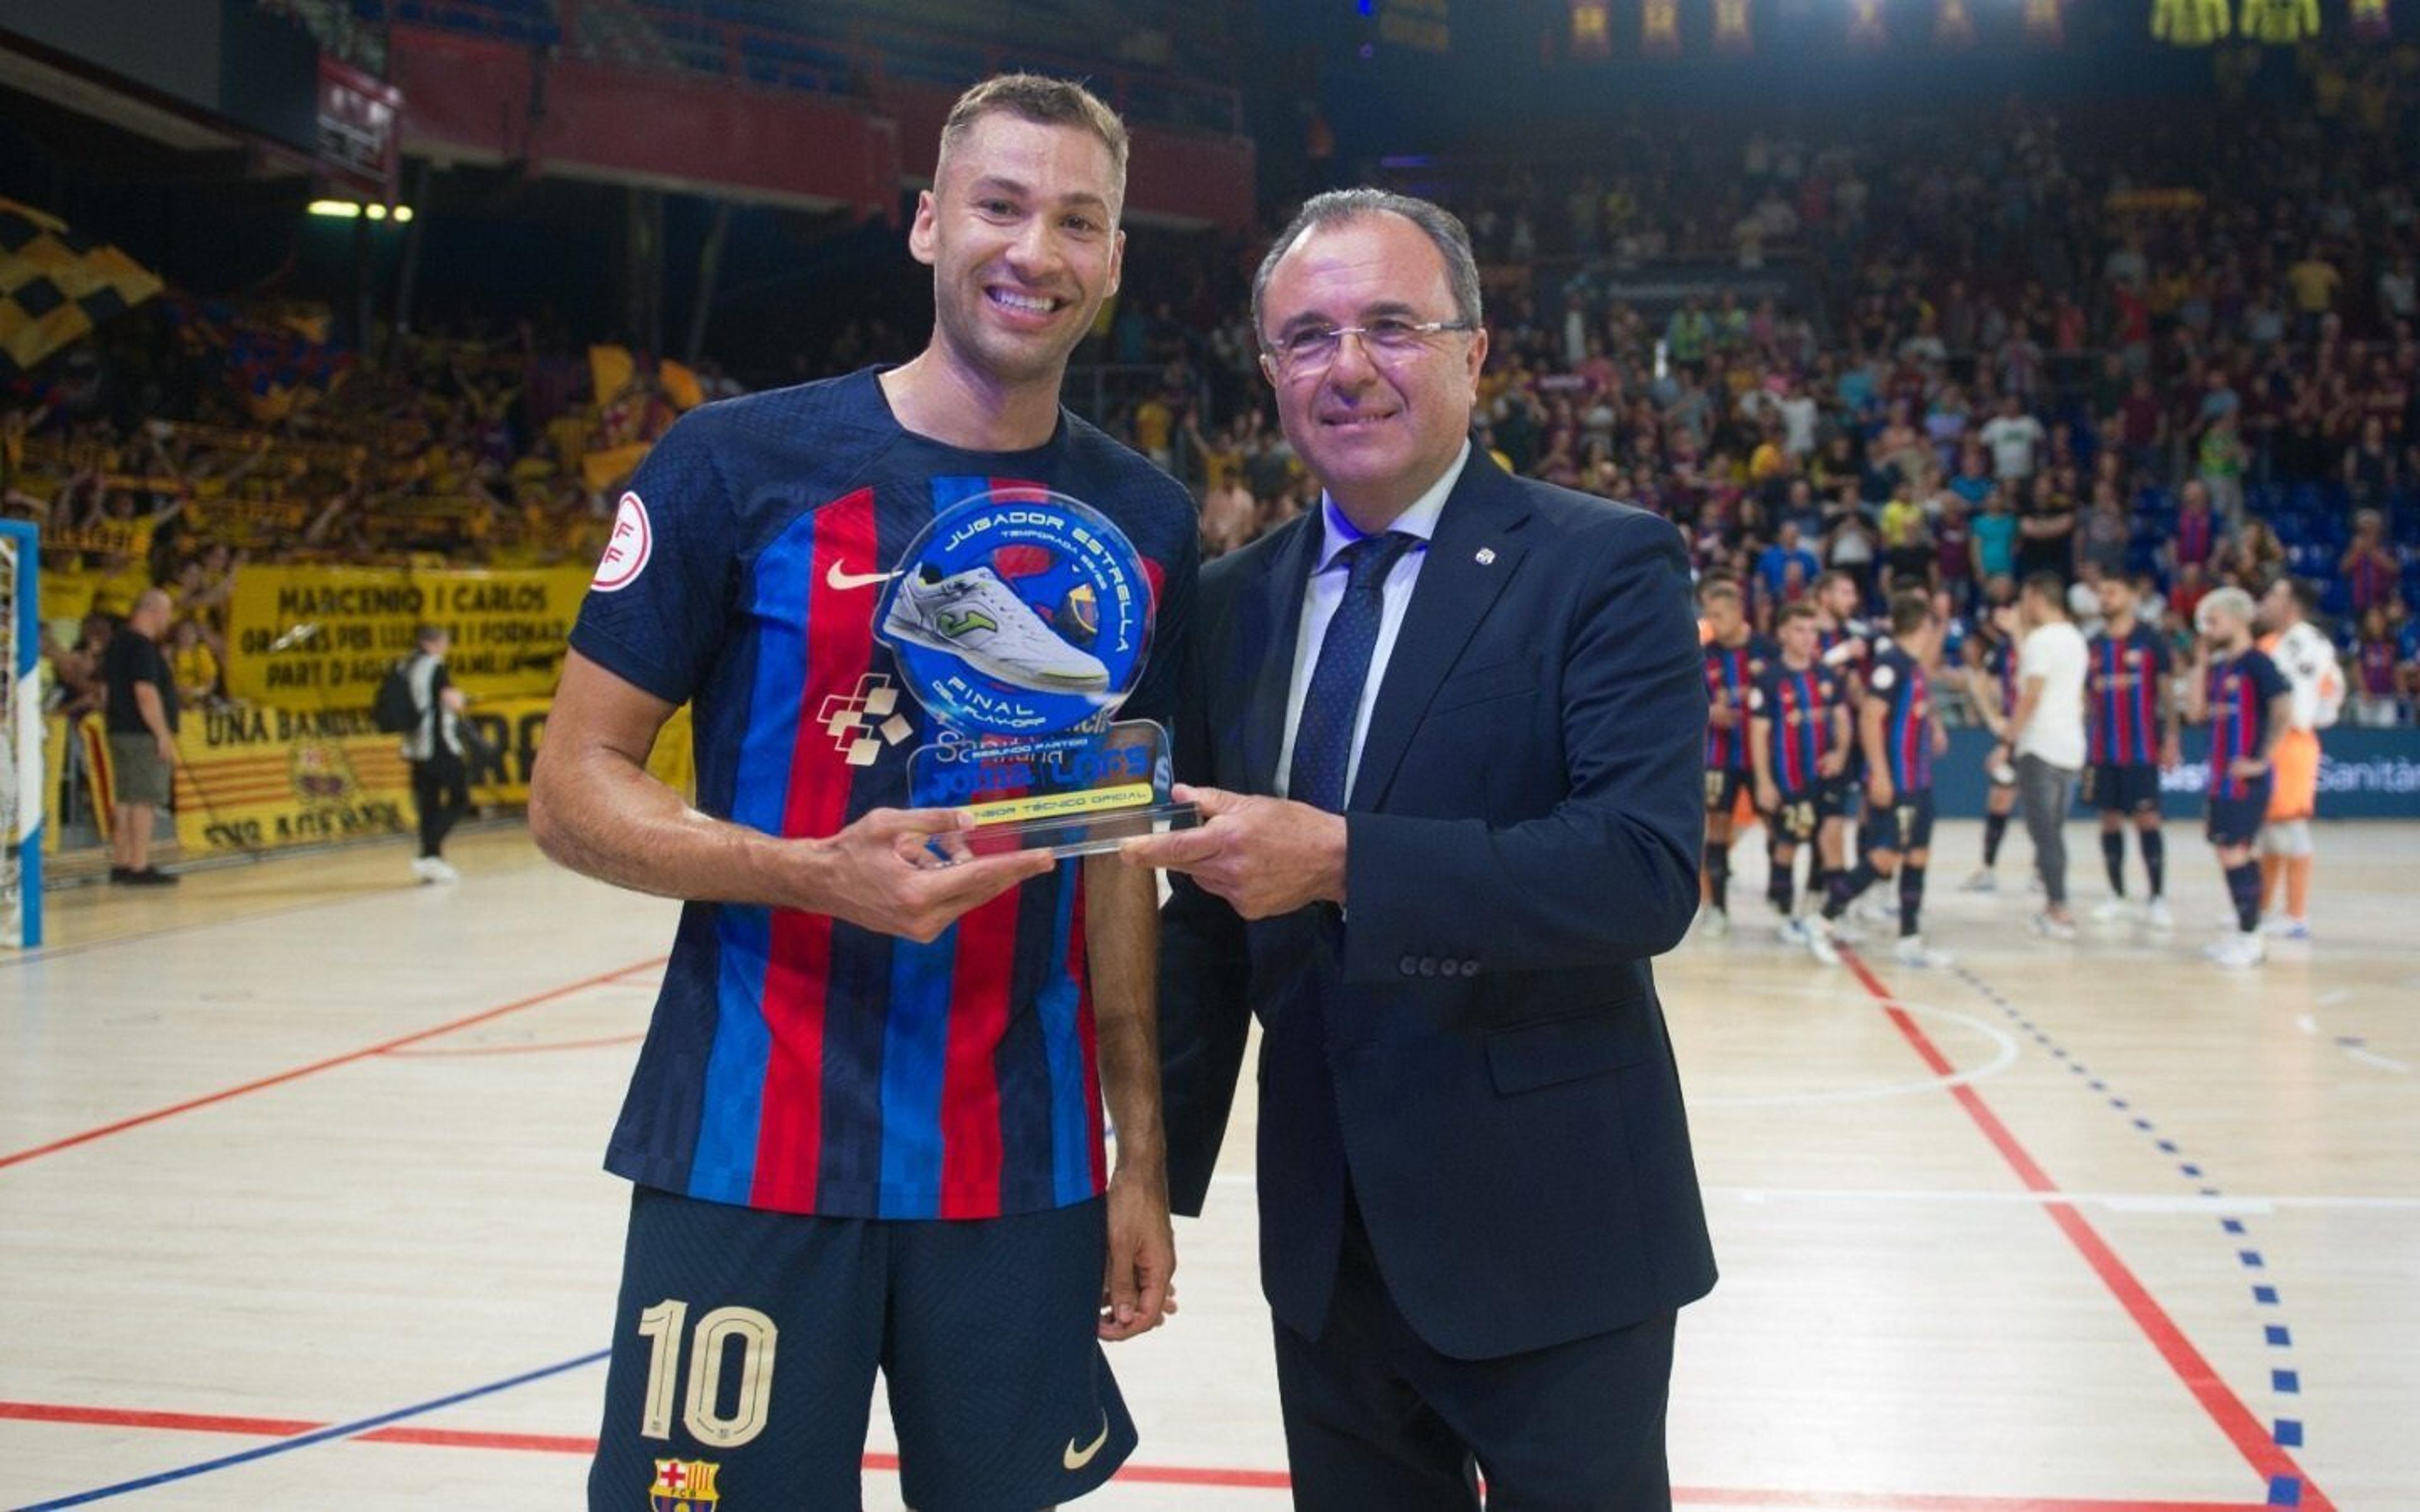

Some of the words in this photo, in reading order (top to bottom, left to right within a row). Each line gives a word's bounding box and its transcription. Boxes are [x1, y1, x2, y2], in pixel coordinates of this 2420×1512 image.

[451, 584, 547, 612] CARLOS
[945, 511, 1066, 553] JUGADOR
[1072, 527, 1132, 653] ESTRELLA
[948, 677, 1035, 715] FINAL
[638, 1298, 779, 1448] 10
